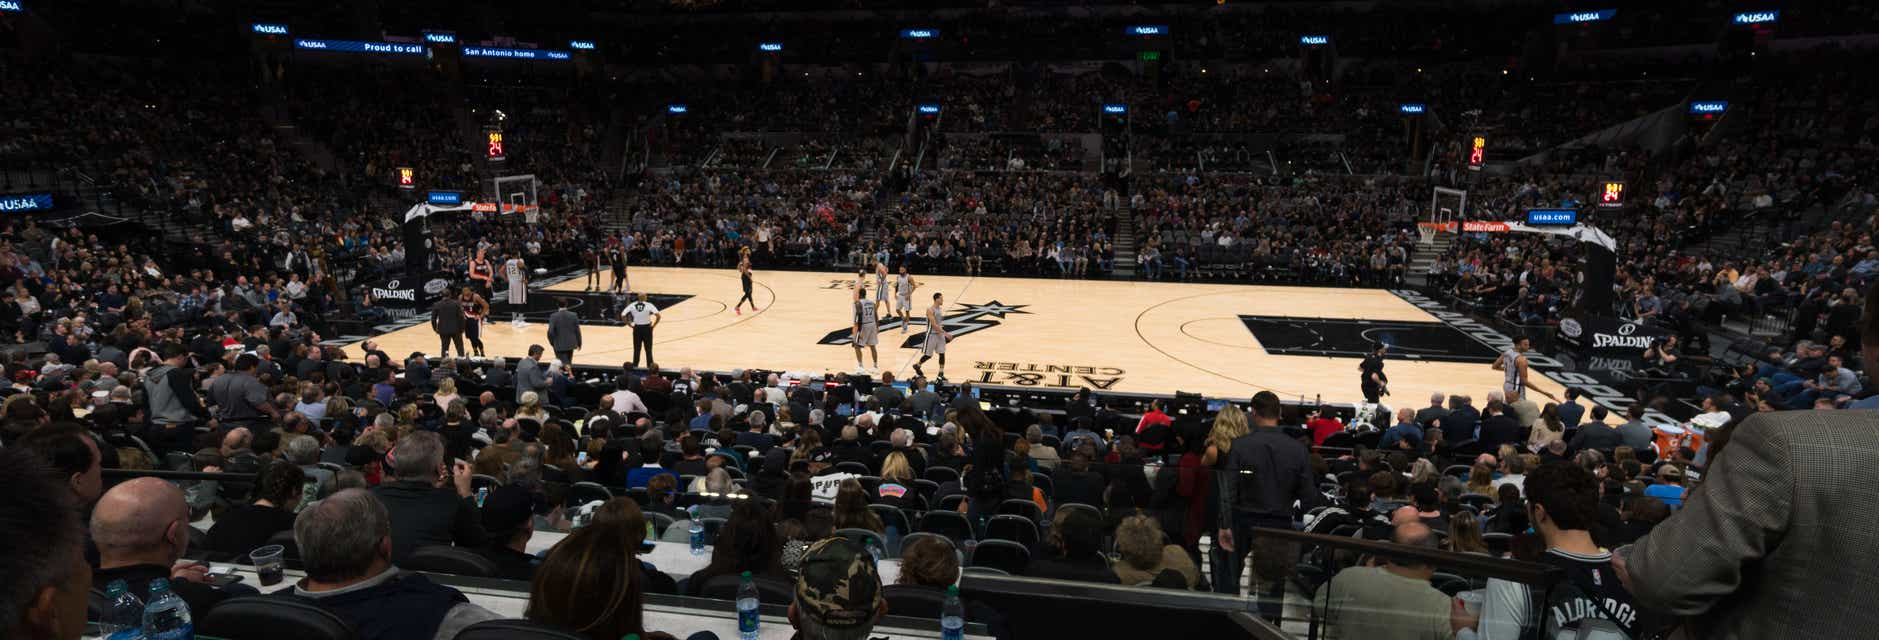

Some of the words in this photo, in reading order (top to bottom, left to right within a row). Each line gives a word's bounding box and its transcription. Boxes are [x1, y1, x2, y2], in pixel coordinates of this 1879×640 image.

[0, 0, 20, 10] SAA
[1748, 13, 1775, 23] USAA
[264, 25, 287, 34] USAA
[364, 43, 391, 51] Proud
[394, 43, 403, 52] to
[406, 44, 422, 53] call
[465, 48, 480, 56] San
[482, 48, 512, 57] Antonio
[514, 50, 535, 58] home
[490, 142, 501, 156] 24
[1471, 147, 1483, 163] 24
[1604, 191, 1618, 201] 24
[4, 198, 38, 210] USAA
[1533, 213, 1571, 221] usaa.com
[373, 287, 415, 301] SPALDING
[1592, 333, 1655, 349] SPALDIN
[974, 361, 1126, 376] CENTER
[966, 371, 1122, 391] AT&T
